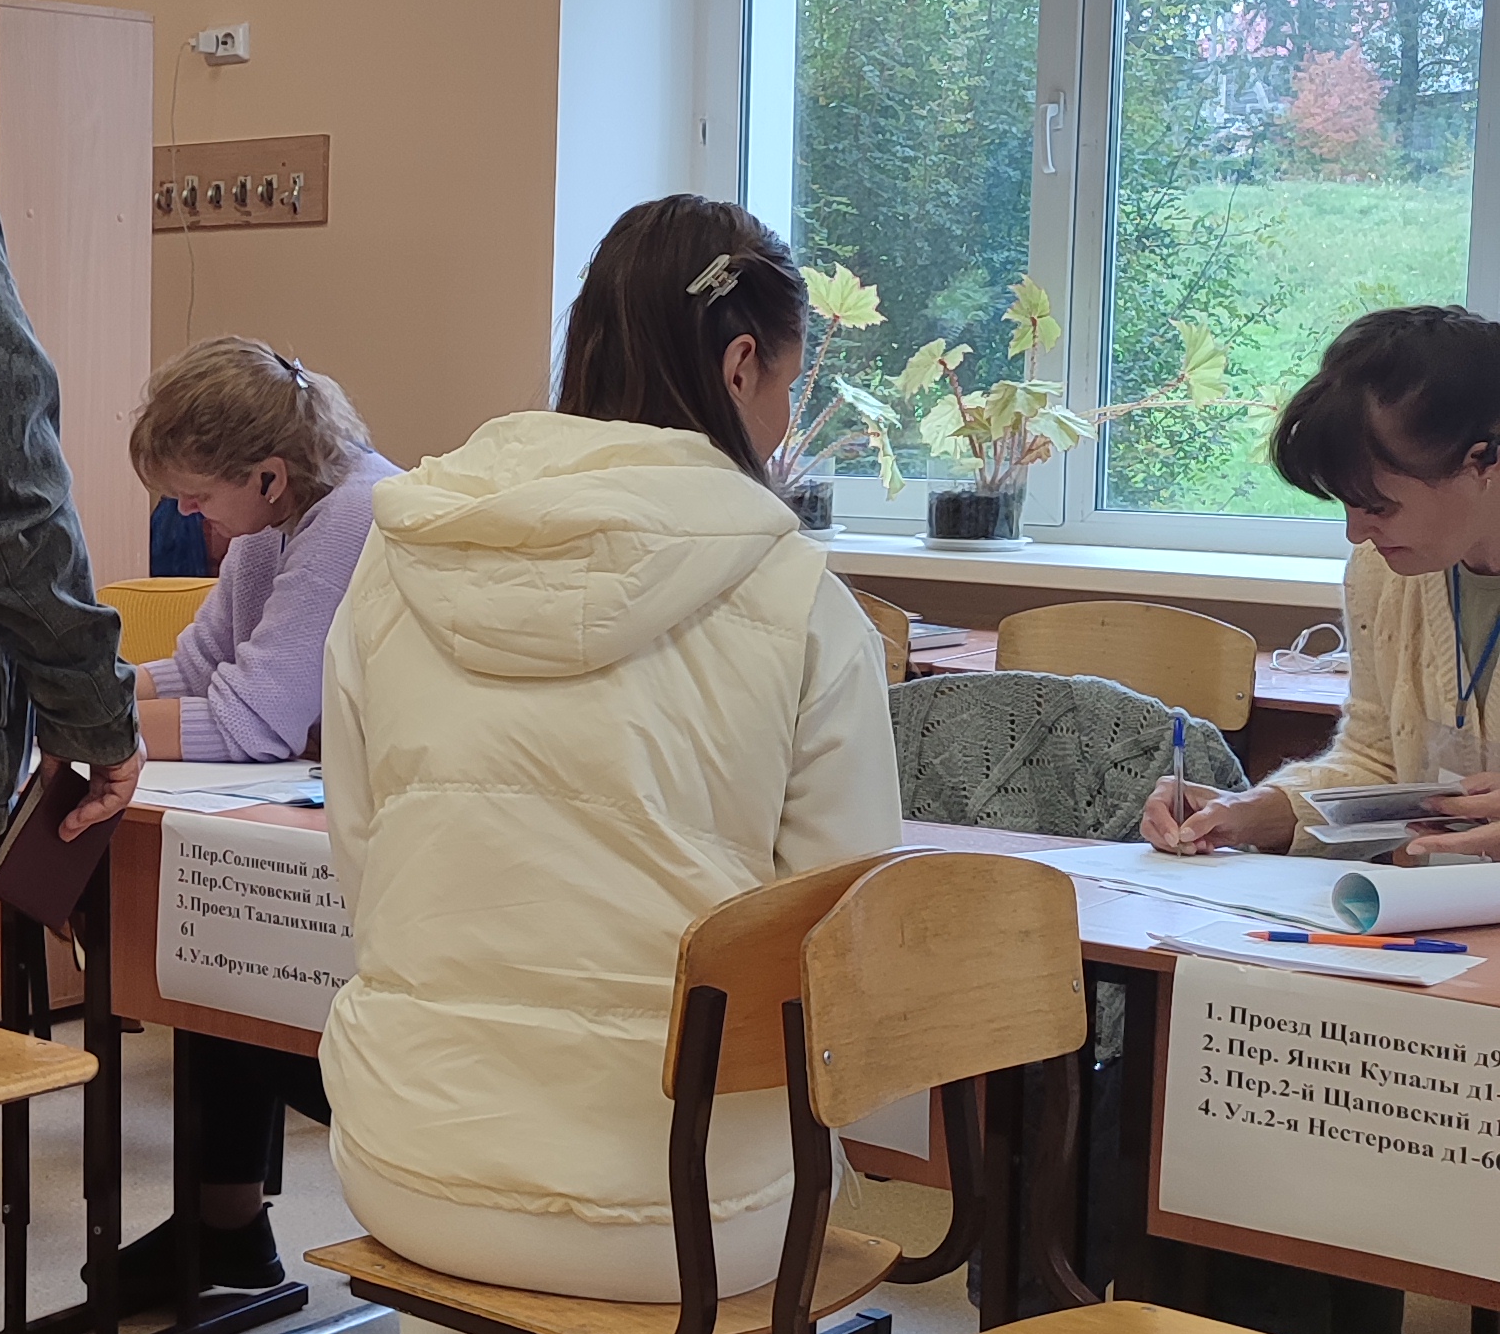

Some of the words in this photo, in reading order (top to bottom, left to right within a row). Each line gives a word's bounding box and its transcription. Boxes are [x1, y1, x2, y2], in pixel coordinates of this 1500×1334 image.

[180, 921, 195, 937] 61
[244, 905, 336, 935] Талалихина
[1205, 1002, 1223, 1021] 1.
[1229, 1005, 1312, 1038] Проезд
[1320, 1020, 1467, 1063] Щаповский
[1202, 1033, 1221, 1053] 2.
[1227, 1037, 1279, 1066] Пер.
[1287, 1048, 1351, 1076] Янки
[1360, 1060, 1459, 1096] Купалы
[1197, 1098, 1217, 1117] 4.
[1308, 1116, 1434, 1158] Нестерова
[1199, 1065, 1219, 1085] 3.
[1324, 1087, 1470, 1131] Щаповский
